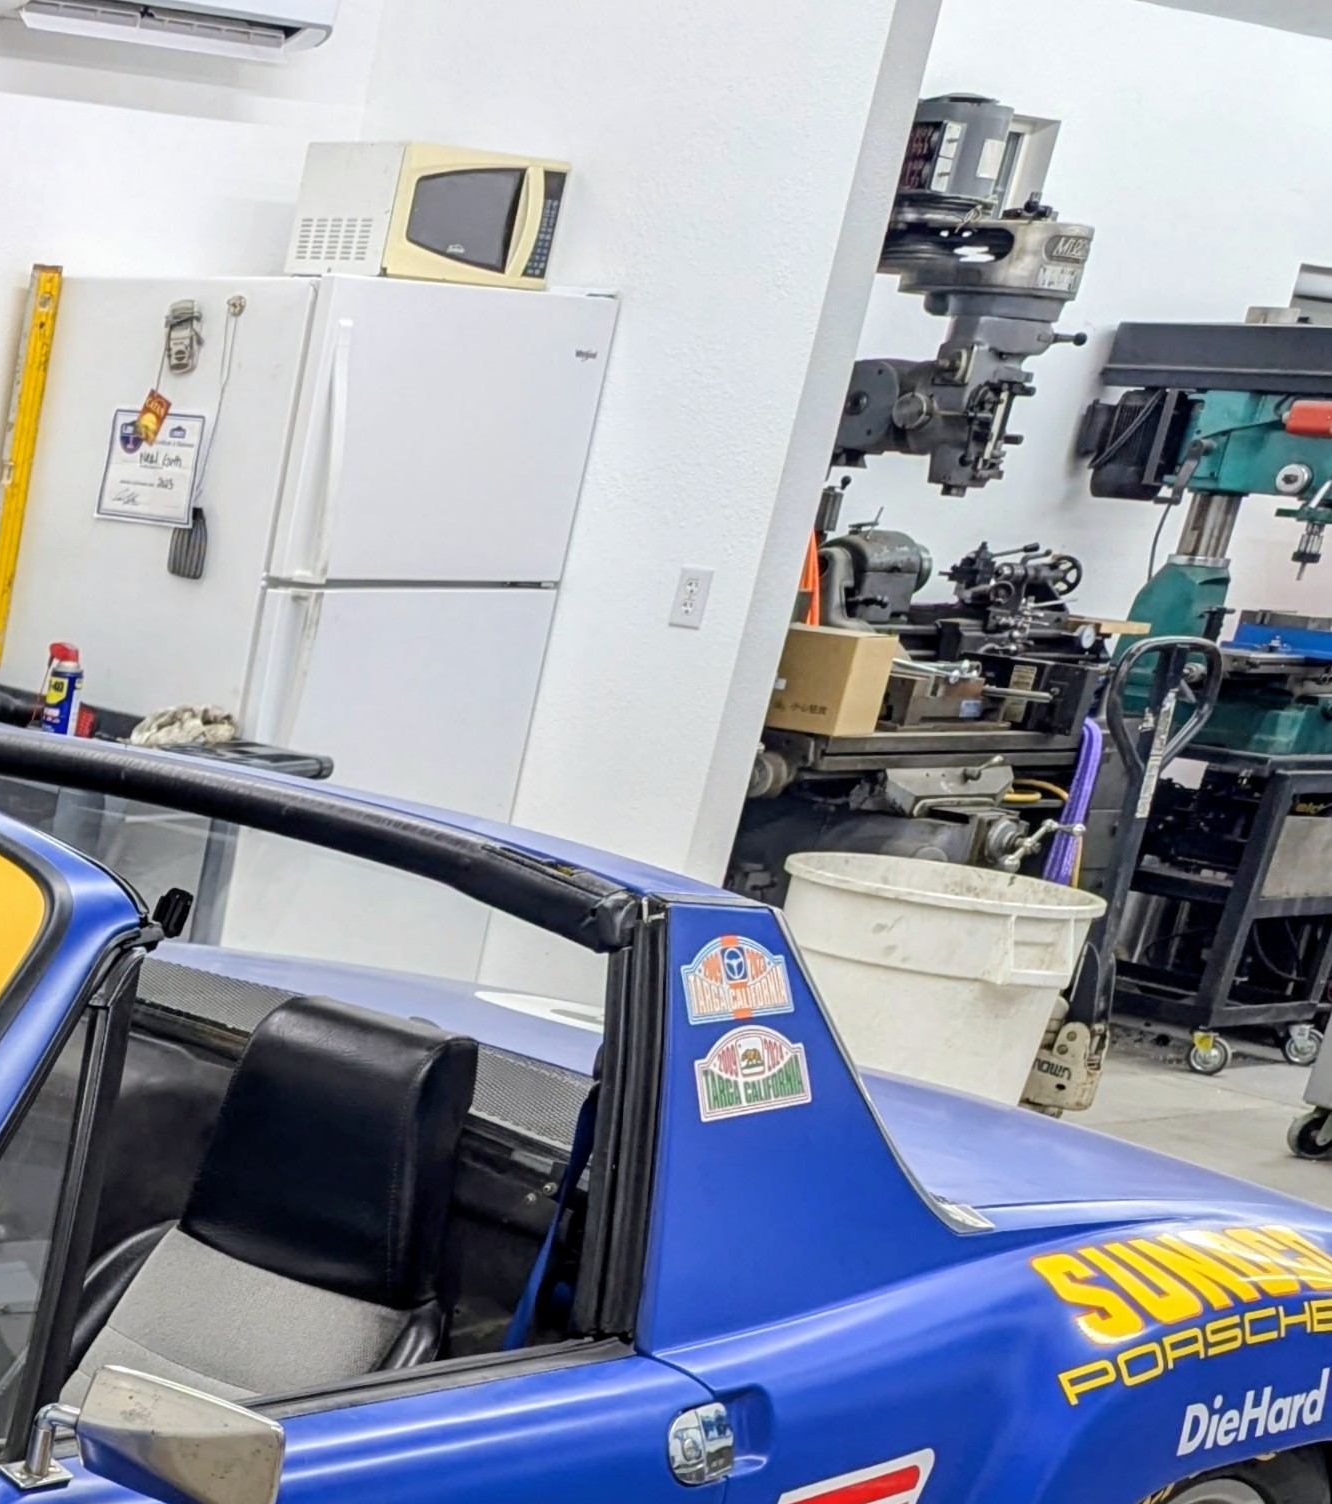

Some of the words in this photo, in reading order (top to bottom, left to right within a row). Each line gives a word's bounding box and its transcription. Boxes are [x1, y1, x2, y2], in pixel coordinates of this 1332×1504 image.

[146, 399, 167, 416] CATAN
[688, 974, 729, 1014] TARGA
[729, 964, 789, 1010] CALIFORNIA
[703, 1069, 743, 1111] TARGA
[743, 1053, 805, 1104] CALIFORNIA
[717, 1044, 738, 1078] 2009
[763, 1037, 784, 1072] 2024
[1176, 1367, 1331, 1457] DieHard
